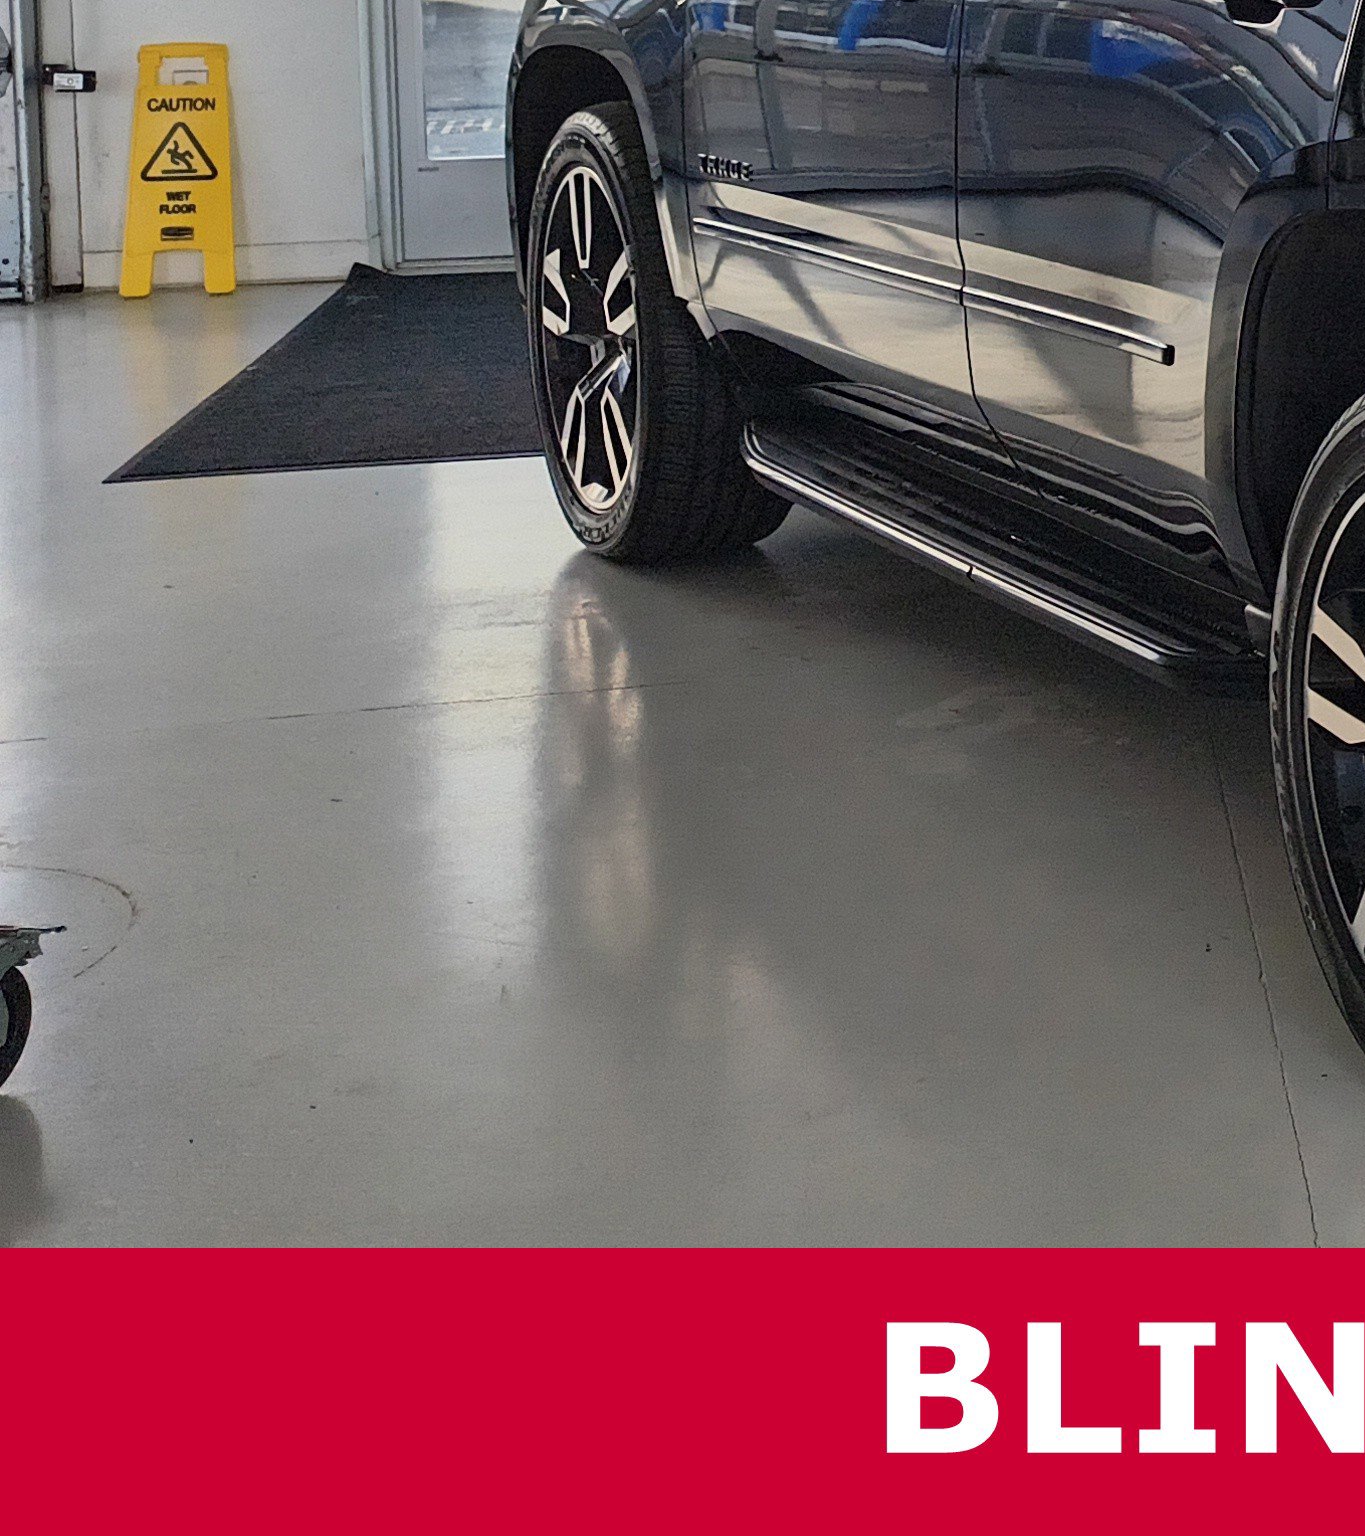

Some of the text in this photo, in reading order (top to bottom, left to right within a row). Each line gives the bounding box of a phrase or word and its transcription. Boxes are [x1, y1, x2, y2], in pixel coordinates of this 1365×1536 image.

[146, 97, 216, 113] CAUTION
[697, 153, 754, 182] TAHOE
[165, 190, 192, 202] WET
[159, 203, 197, 215] FLOOR
